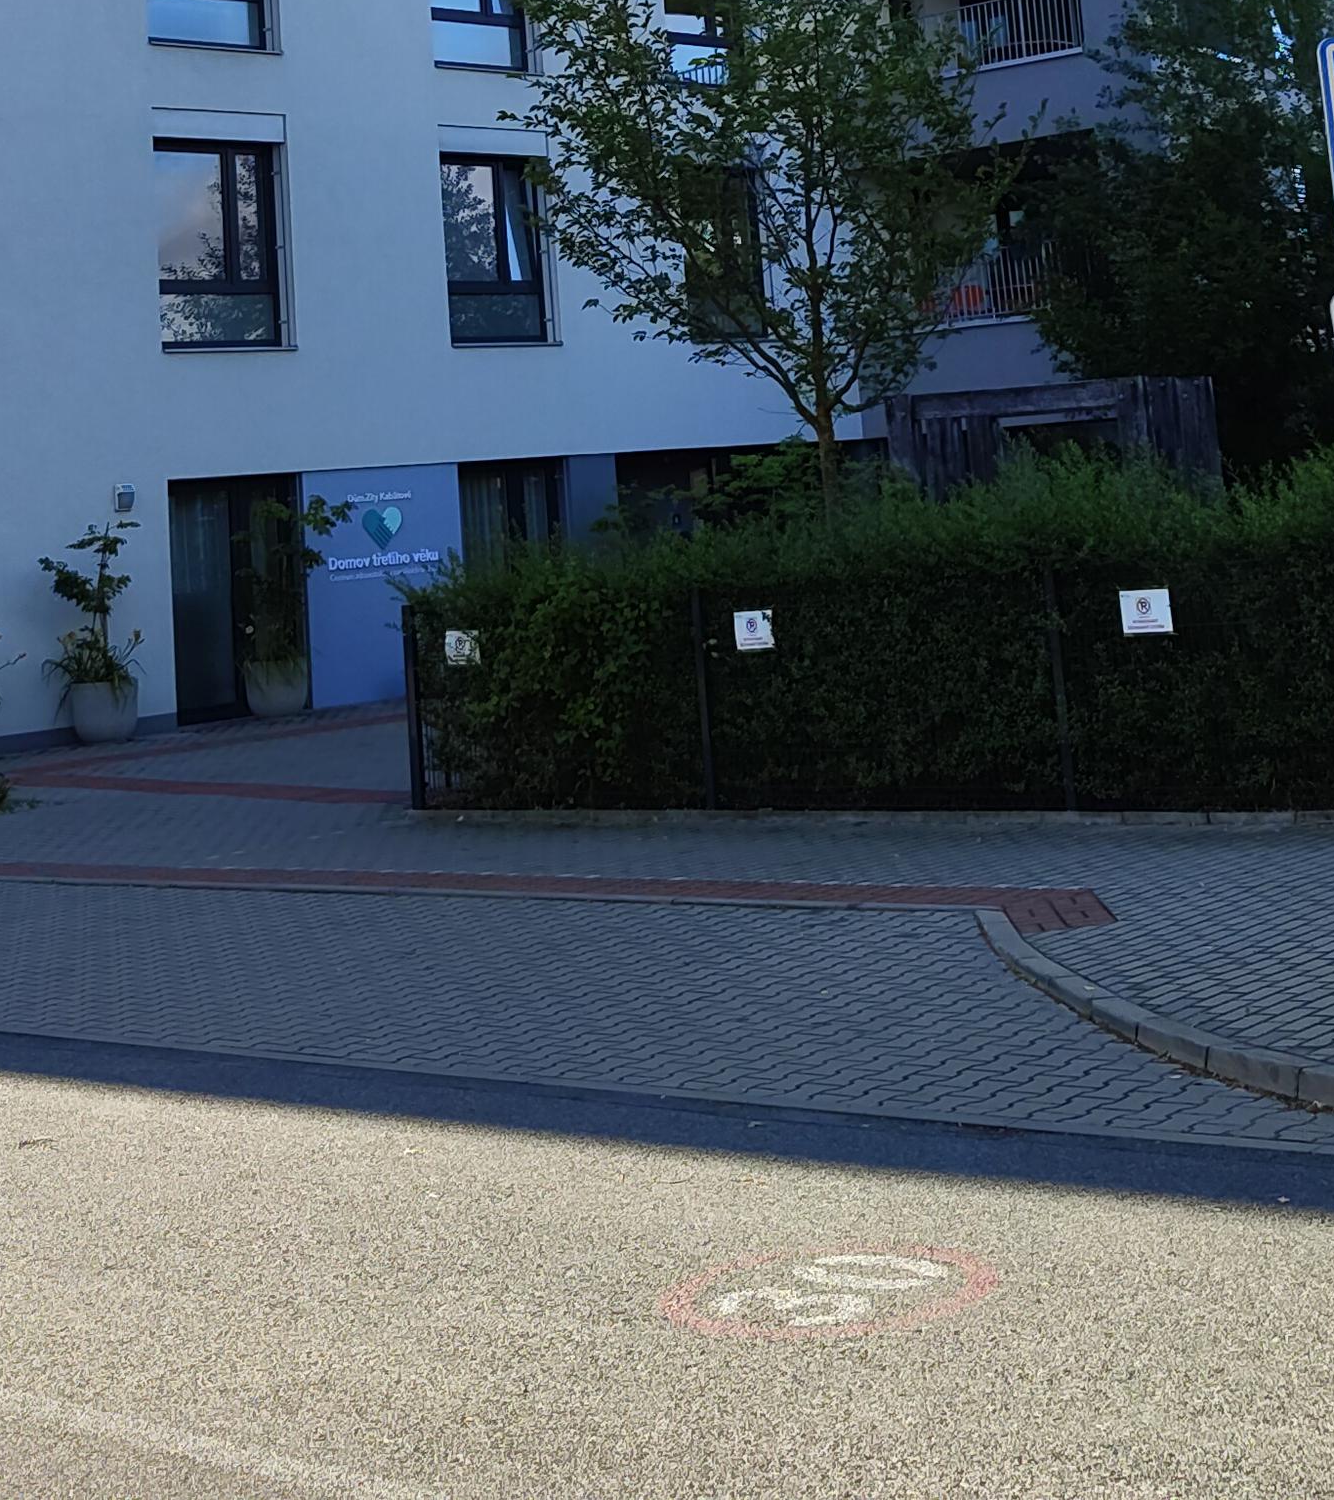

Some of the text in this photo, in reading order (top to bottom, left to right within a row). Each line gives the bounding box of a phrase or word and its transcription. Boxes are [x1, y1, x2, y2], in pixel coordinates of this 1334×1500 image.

[328, 548, 440, 571] Domov třetího věku
